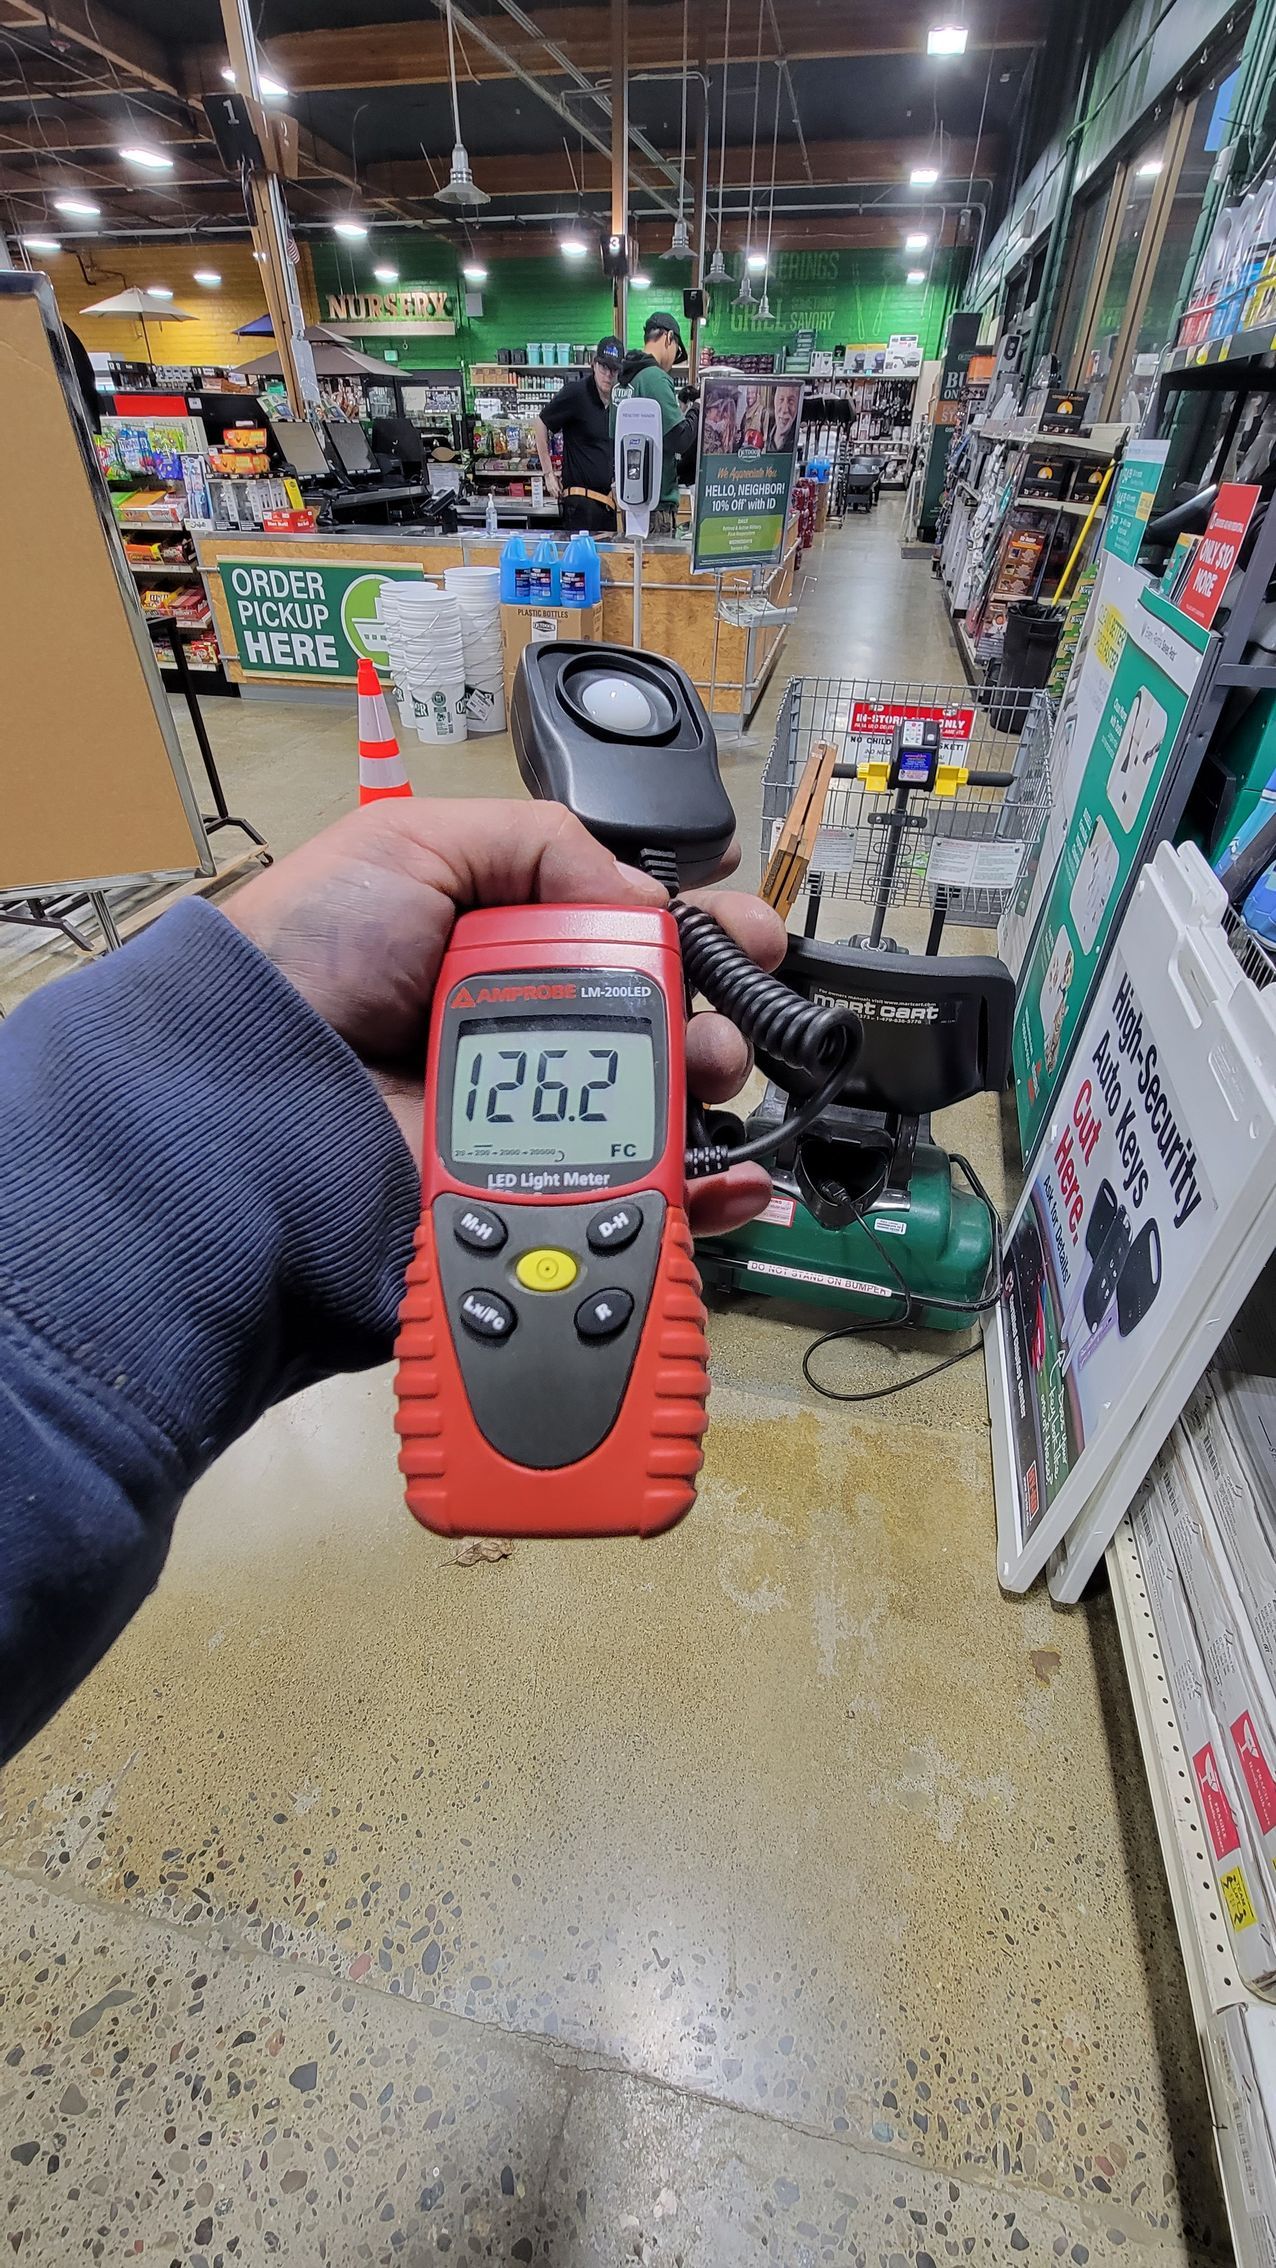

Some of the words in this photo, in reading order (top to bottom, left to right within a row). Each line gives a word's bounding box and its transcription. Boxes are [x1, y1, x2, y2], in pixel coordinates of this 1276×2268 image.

[223, 99, 240, 124] 1
[609, 236, 620, 249] 3
[326, 291, 447, 319] NURSERY
[690, 290, 698, 299] 5
[790, 311, 836, 331] SAVORY
[717, 467, 729, 479] We
[729, 467, 765, 480] Appreciate
[705, 484, 736, 498] HELLO,
[738, 482, 785, 496] NEIGHBOR!
[712, 500, 730, 512] 10%
[747, 499, 766, 511] with
[767, 498, 776, 509] ID
[1199, 538, 1222, 564] ONLY
[1215, 543, 1235, 571] $10
[231, 568, 326, 600] ORDER
[1192, 568, 1219, 598] MORE
[237, 600, 329, 630] PICKUP
[517, 608, 542, 617] PLASTIC
[543, 609, 569, 619] BOTTLES
[243, 630, 339, 668] HERE
[866, 737, 892, 745] CHILD
[939, 742, 964, 751] SKET!
[476, 983, 577, 1004] AMPROBE
[581, 986, 651, 998] LM-200LED
[828, 991, 847, 999] owners
[465, 1049, 619, 1123] 126.2
[1112, 972, 1202, 1229] High-Security
[1073, 1079, 1102, 1167] Cut
[1092, 1029, 1121, 1117] Auto
[1115, 1097, 1149, 1209] Keys
[474, 1149, 491, 1157] 200
[610, 1144, 637, 1157] FC
[487, 1173, 517, 1188] LED
[520, 1172, 560, 1190] Light
[563, 1172, 611, 1187] Meter
[1054, 1124, 1084, 1248] Here.
[598, 1211, 630, 1238] D-H
[1043, 1174, 1053, 1206] Ask
[1049, 1201, 1060, 1227] for
[1055, 1226, 1072, 1288] Details!
[751, 1262, 766, 1271] DO
[768, 1265, 788, 1275] NOT
[791, 1269, 824, 1283] STAND
[827, 1277, 842, 1286] ON
[845, 1280, 887, 1296] BUMPER
[594, 1303, 613, 1322] R
[1018, 1379, 1026, 1419] Center
[1048, 1385, 1057, 1422] key
[1058, 1432, 1068, 1465] your
[1256, 1768, 1272, 1809] FRAGILE
[1207, 1793, 1216, 1819] Handle
[1214, 1801, 1227, 1840] FRAGILE
[1235, 1880, 1246, 1906] TEAM
